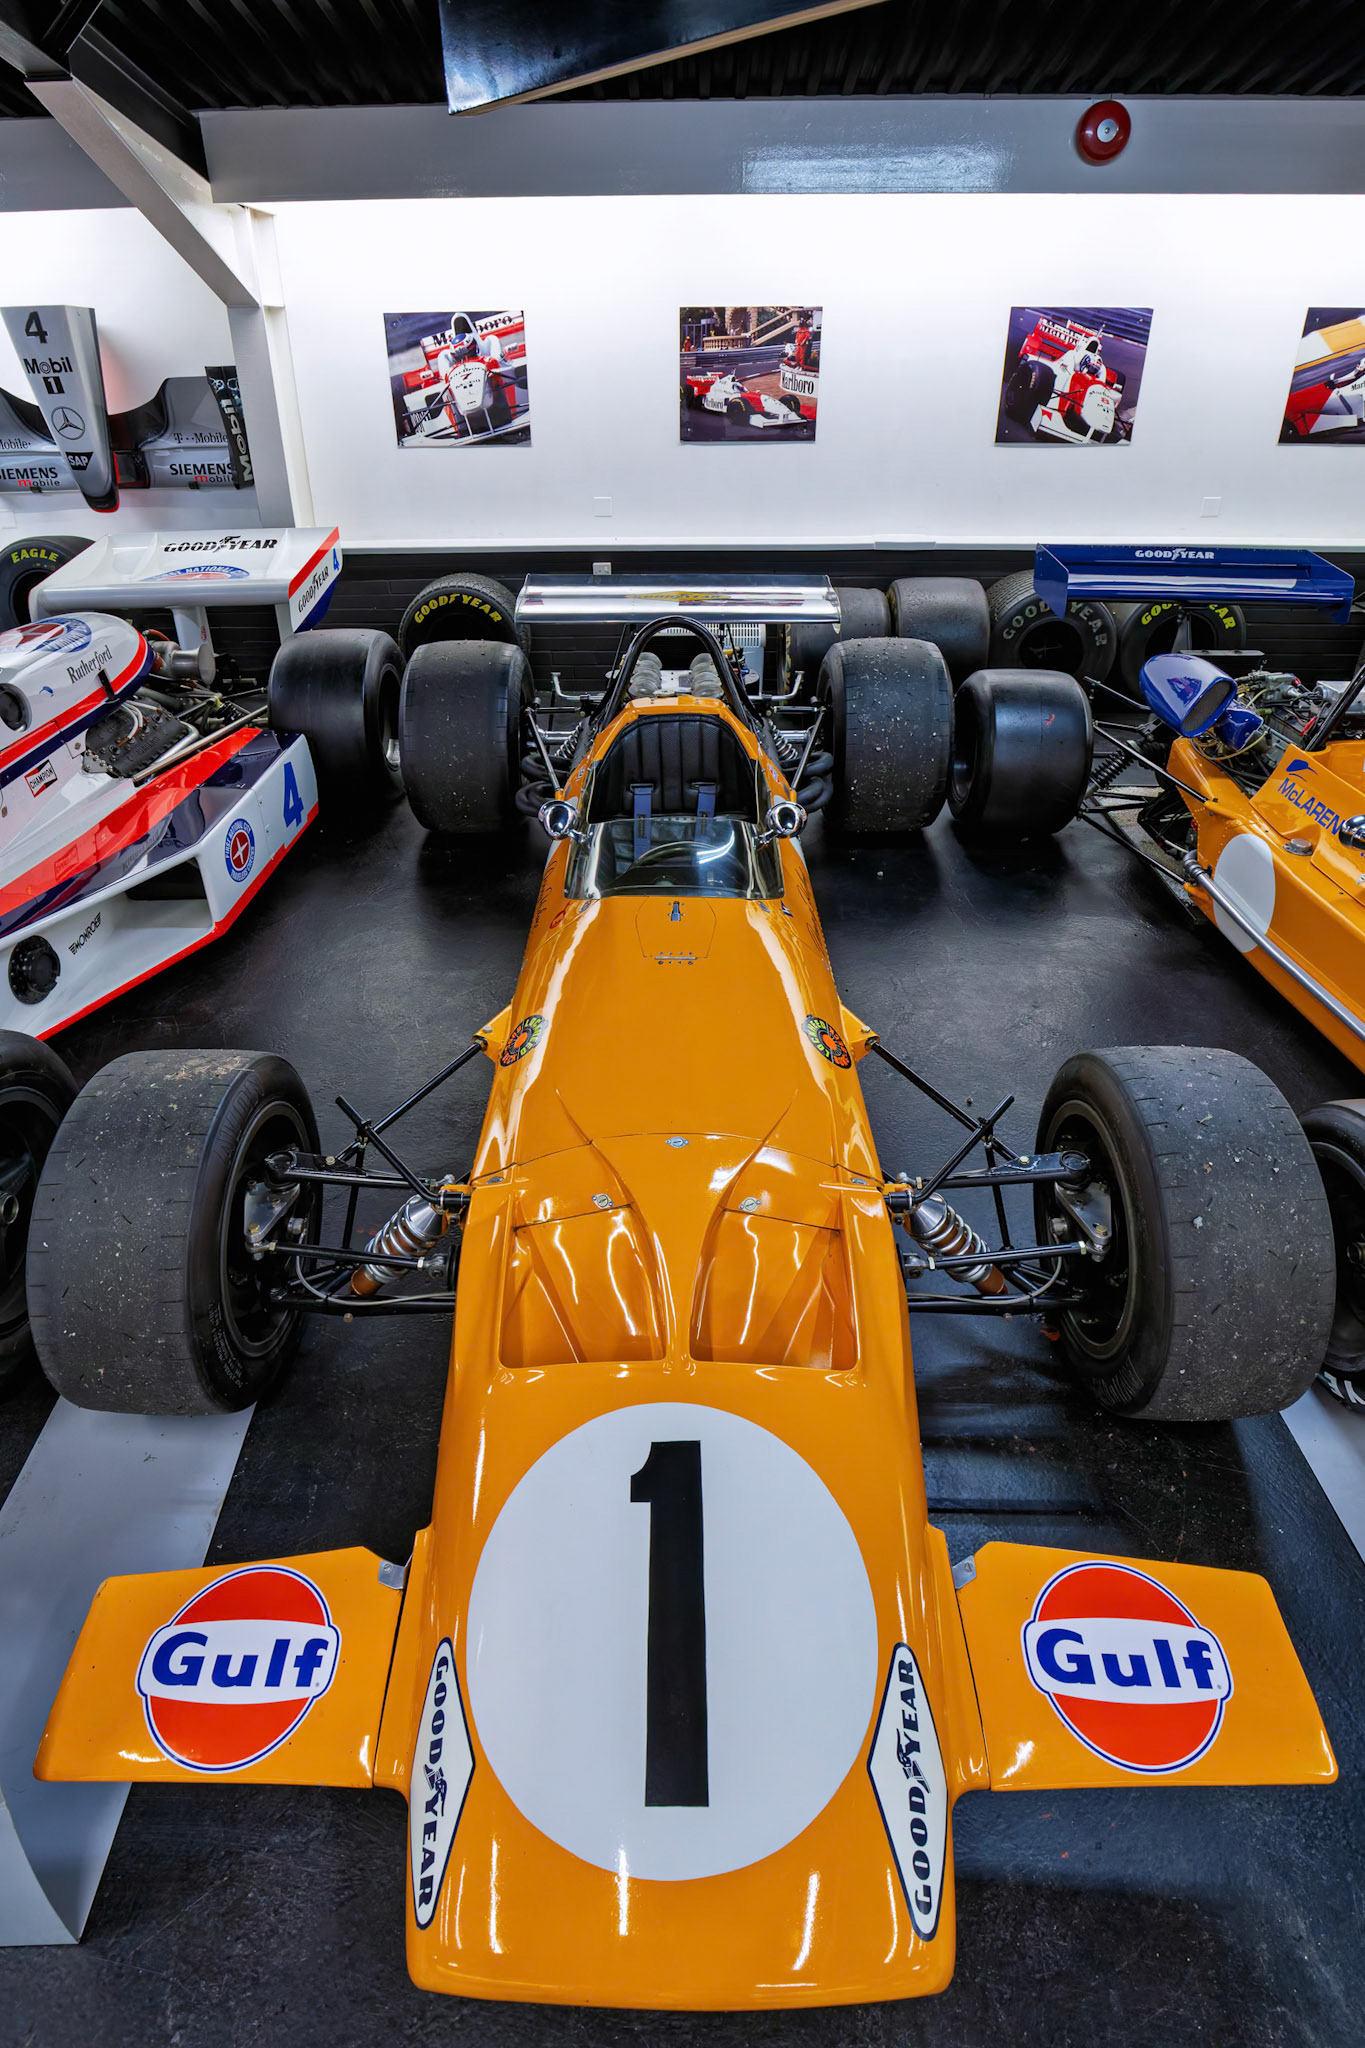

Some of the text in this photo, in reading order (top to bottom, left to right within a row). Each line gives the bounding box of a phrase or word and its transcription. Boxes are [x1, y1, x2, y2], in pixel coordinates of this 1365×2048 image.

[25, 311, 48, 343] 4
[431, 315, 513, 347] Mboro
[23, 356, 73, 375] Mobil
[46, 377, 62, 394] 1
[220, 399, 254, 481] Mobil
[0, 467, 58, 480] IEMENS
[68, 455, 89, 467] SAP
[169, 463, 232, 476] SIEMENS
[18, 479, 60, 488] mobile
[194, 475, 234, 483] mobil
[11, 548, 59, 563] EAGLE
[332, 548, 340, 571] 4
[66, 644, 113, 684] Rutherford
[30, 768, 53, 789] CHAMPION
[283, 762, 304, 828] 4
[1277, 777, 1347, 835] McLAREN
[630, 1440, 709, 1807] 1
[151, 1631, 329, 1688] Gulf
[1036, 1628, 1215, 1690] Gulf
[418, 1654, 449, 1909] GOODYEAR
[896, 1658, 932, 1916] GOODYEAR
